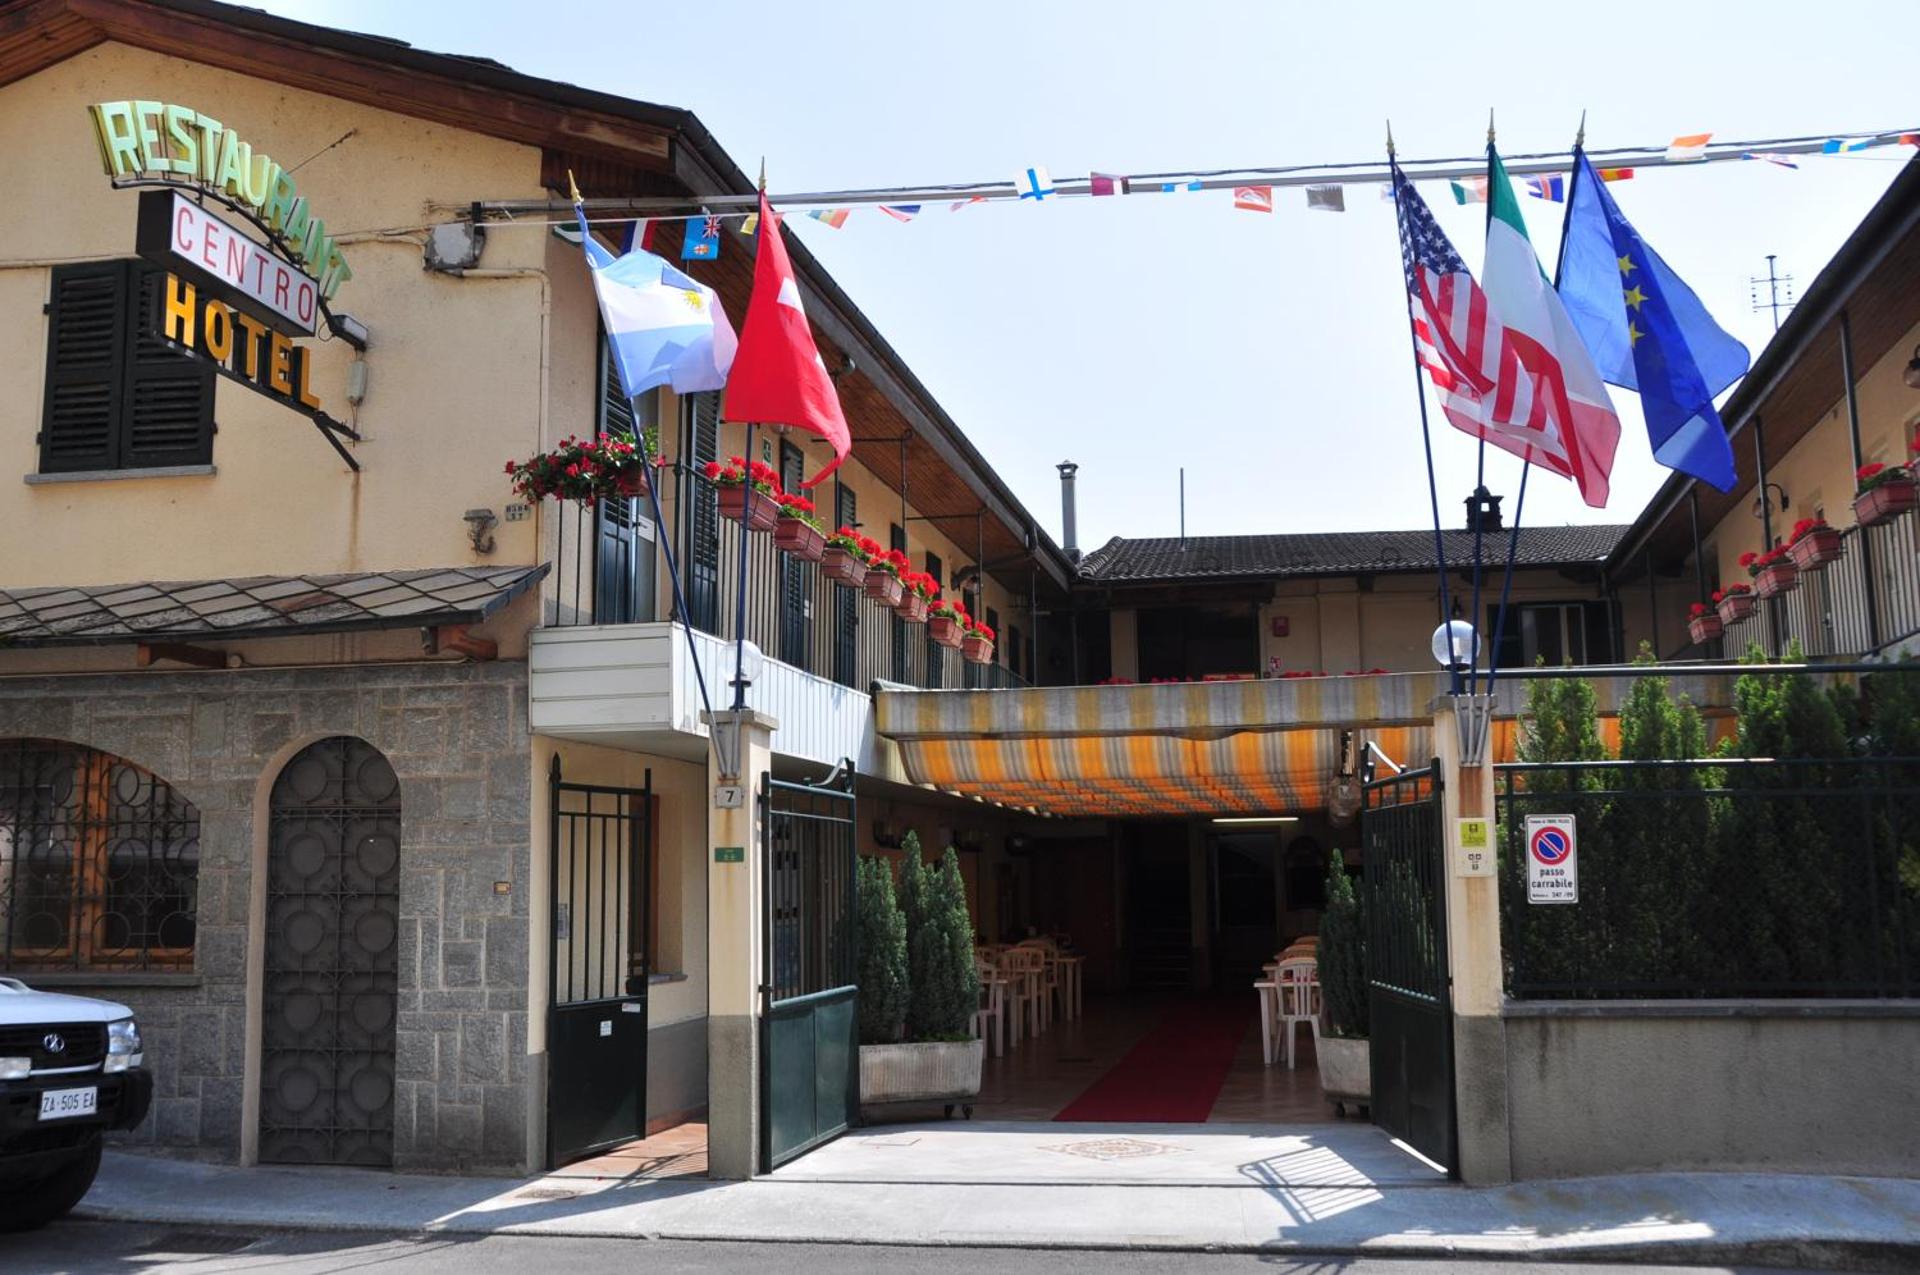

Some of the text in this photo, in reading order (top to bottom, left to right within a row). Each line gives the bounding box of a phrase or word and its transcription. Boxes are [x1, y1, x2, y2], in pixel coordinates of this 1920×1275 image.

[91, 101, 352, 300] RESTAURANT
[175, 205, 314, 324] CENTRO
[164, 272, 320, 411] HOTEL
[725, 790, 734, 802] 7
[1531, 879, 1573, 889] carrabile
[1539, 867, 1565, 878] passo
